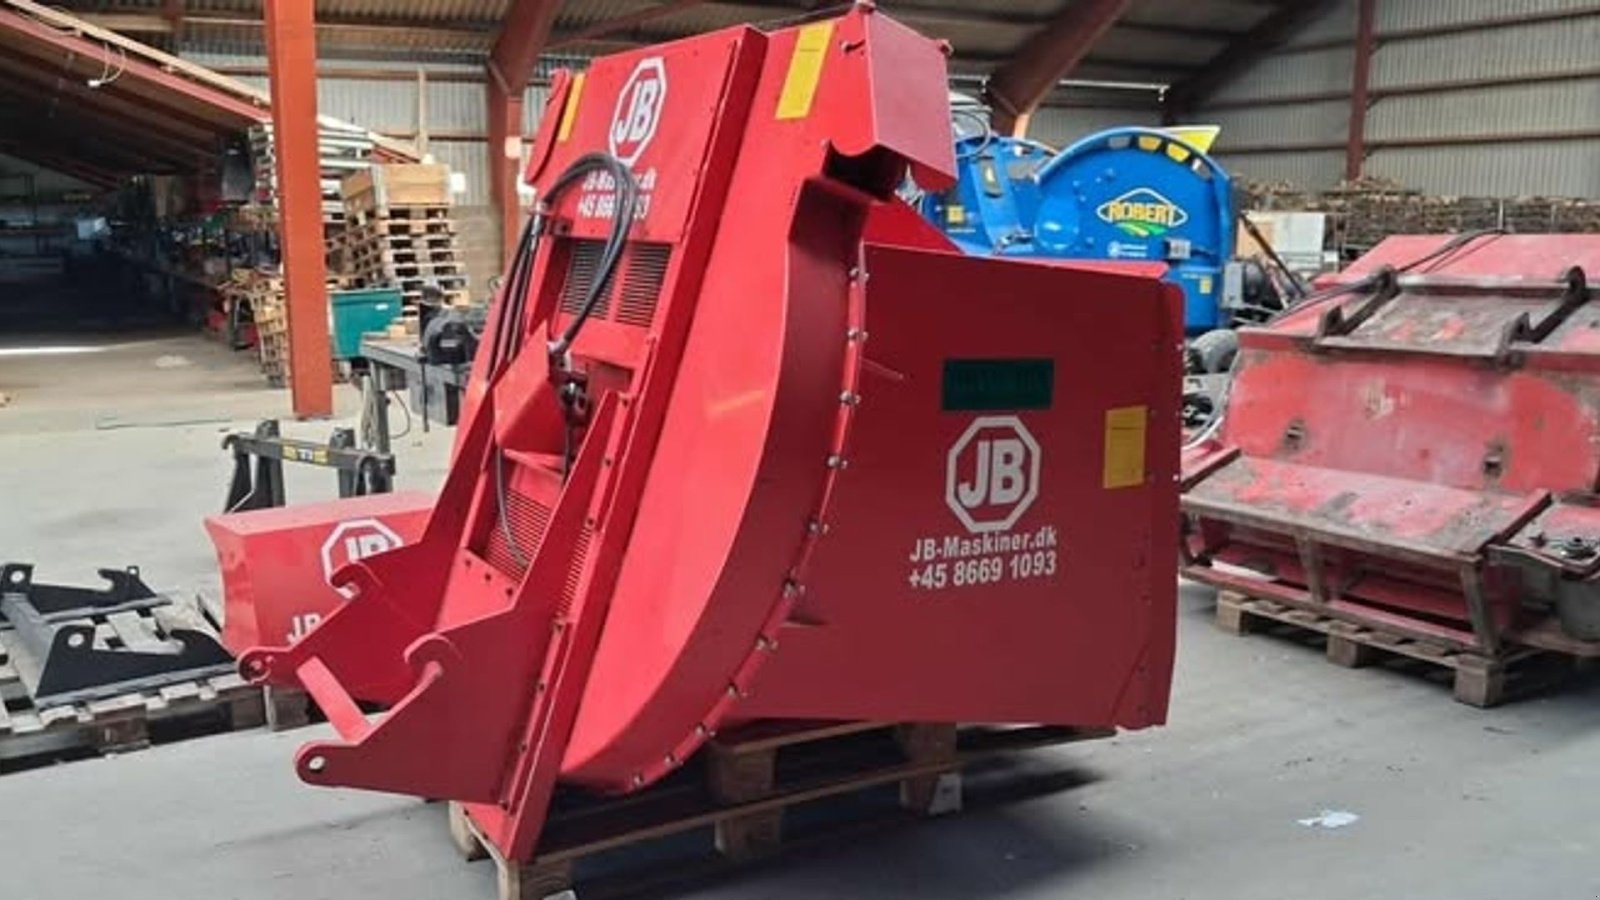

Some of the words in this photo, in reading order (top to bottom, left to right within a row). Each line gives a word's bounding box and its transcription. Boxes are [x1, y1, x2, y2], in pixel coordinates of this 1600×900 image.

[615, 78, 660, 144] JB
[1108, 200, 1175, 227] ROBERT
[958, 438, 1025, 508] JB
[909, 526, 1057, 562] JB-Maskiner.dk
[909, 563, 947, 589] +45
[953, 558, 1003, 587] 8669
[1009, 551, 1057, 579] 1093
